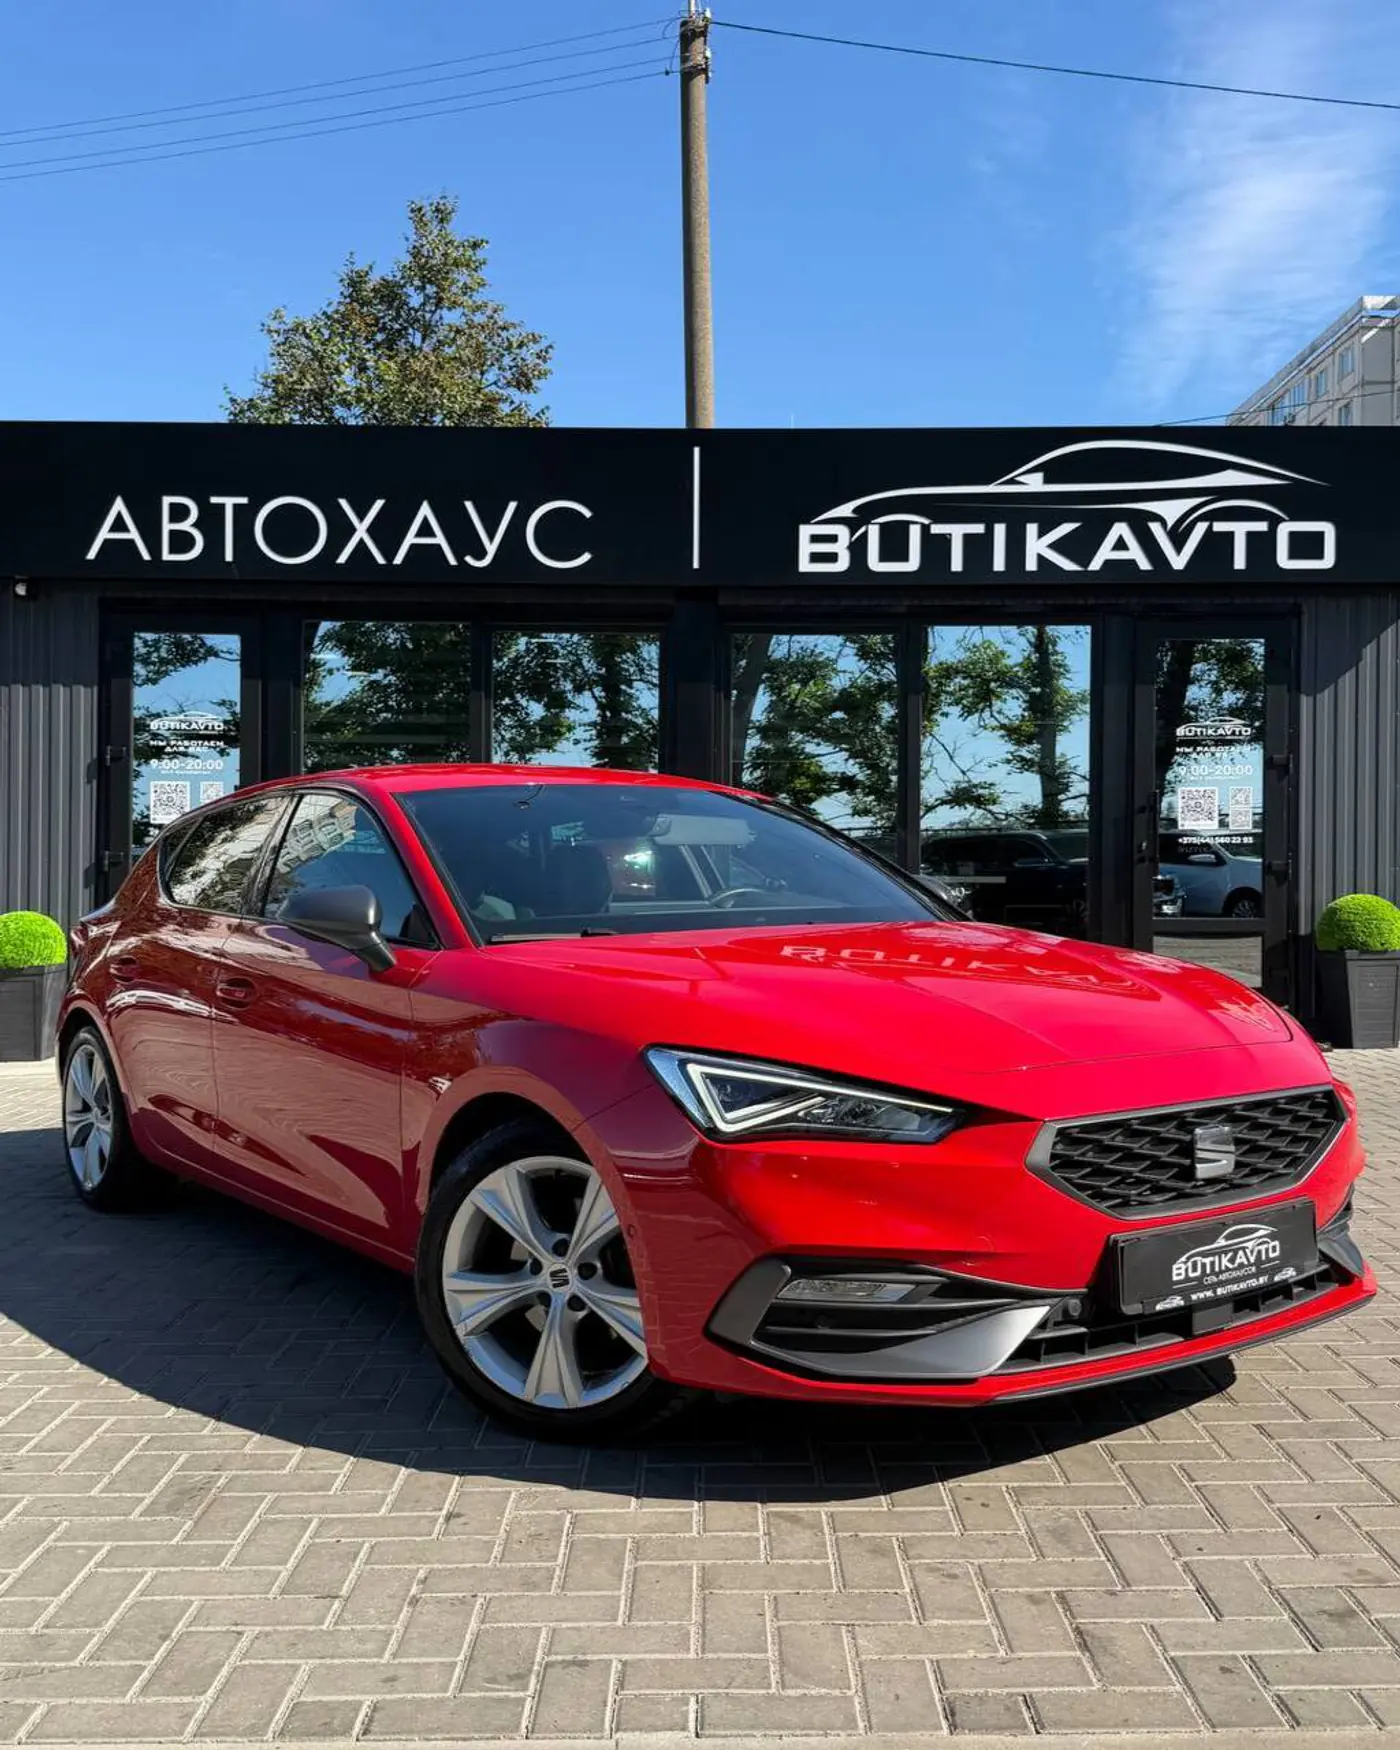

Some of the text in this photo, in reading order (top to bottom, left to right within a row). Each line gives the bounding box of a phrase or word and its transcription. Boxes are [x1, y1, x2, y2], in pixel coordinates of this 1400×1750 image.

[86, 495, 593, 569] АВТОХАУС
[798, 518, 1337, 573] BUTIKAVTO
[150, 720, 224, 730] BUTIKAVTO
[1176, 726, 1251, 736] BUTIKAVTO
[150, 759, 224, 770] 9:00-20:00
[1179, 765, 1254, 775] 9:00-20:00
[1172, 1239, 1280, 1282] BUTIKAVTO
